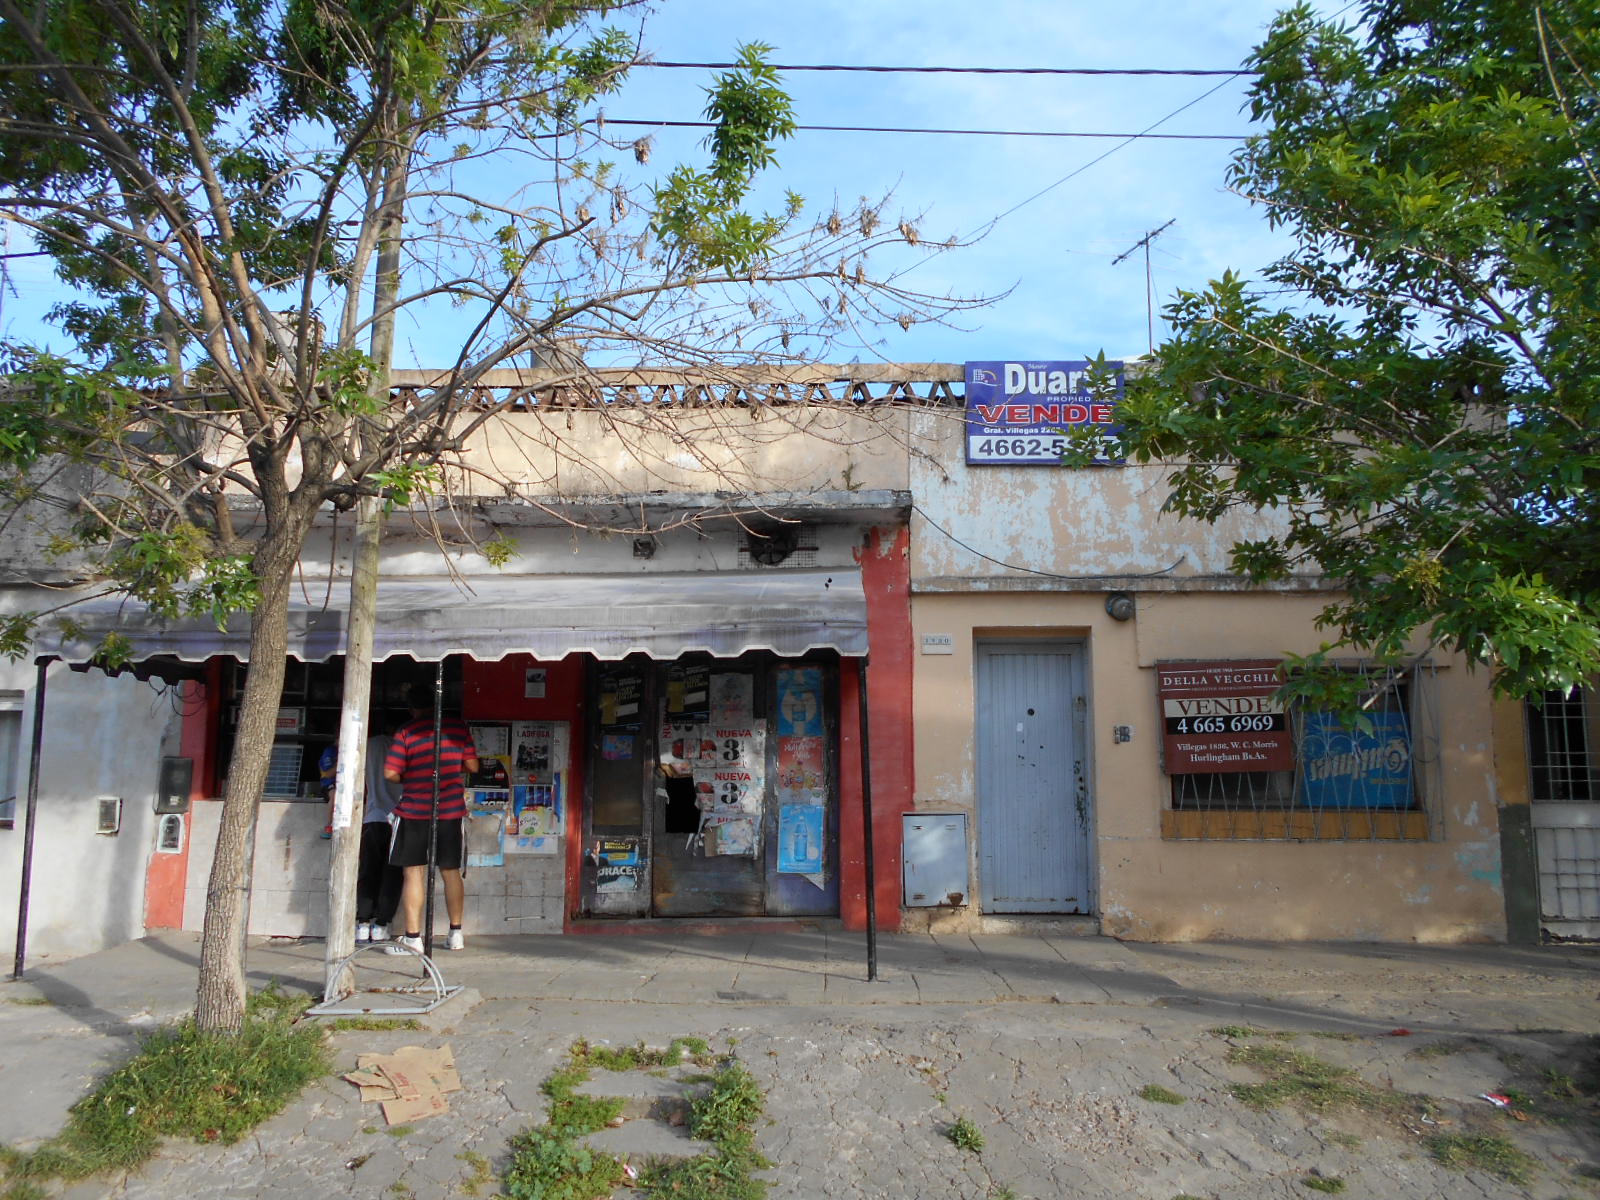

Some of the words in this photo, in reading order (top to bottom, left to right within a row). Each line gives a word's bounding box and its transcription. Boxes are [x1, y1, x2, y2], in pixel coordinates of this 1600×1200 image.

[975, 405, 1114, 424] VENDE
[1006, 427, 1039, 436] Villegas
[979, 438, 1116, 457] 4662-57
[1163, 676, 1208, 686] DELLA
[1214, 673, 1279, 684] VECCHIA
[1176, 697, 1272, 716] VENDE
[1177, 718, 1188, 734] 4
[1193, 717, 1225, 733] 665
[1230, 715, 1273, 732] 6969
[716, 730, 752, 738] NUEVA
[723, 739, 740, 761] 3
[1176, 743, 1208, 753] Villegas
[1252, 741, 1278, 750] Morris
[1190, 753, 1240, 763] Hurlingham
[714, 772, 751, 781] NUEVA
[721, 782, 738, 804] 3
